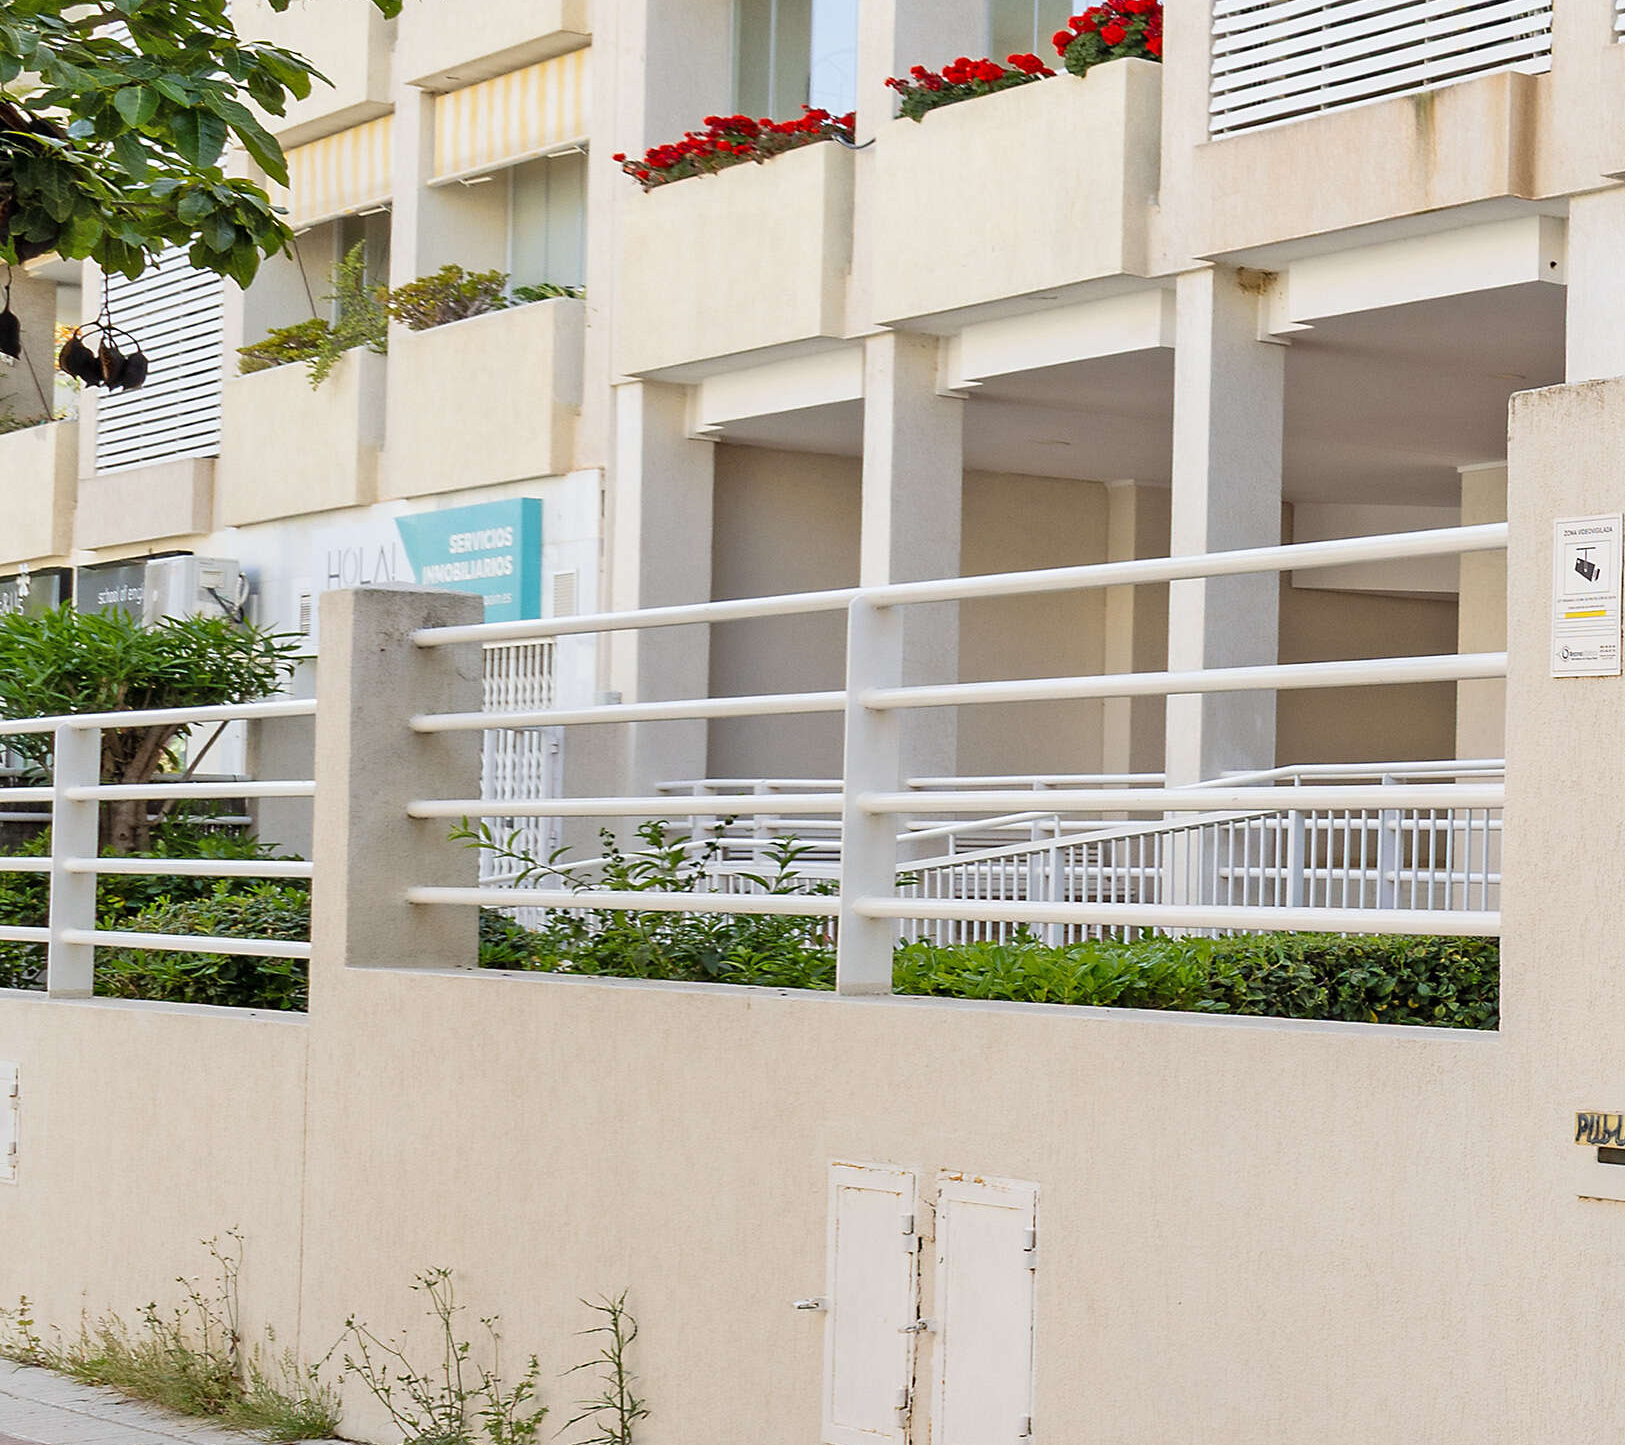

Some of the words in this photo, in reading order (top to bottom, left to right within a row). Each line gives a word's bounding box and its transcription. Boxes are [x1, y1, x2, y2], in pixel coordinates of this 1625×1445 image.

[449, 526, 513, 554] SERVICIOS
[328, 542, 397, 589] HOLA!
[422, 555, 513, 585] INMOBILIARIOS
[97, 586, 119, 605] school
